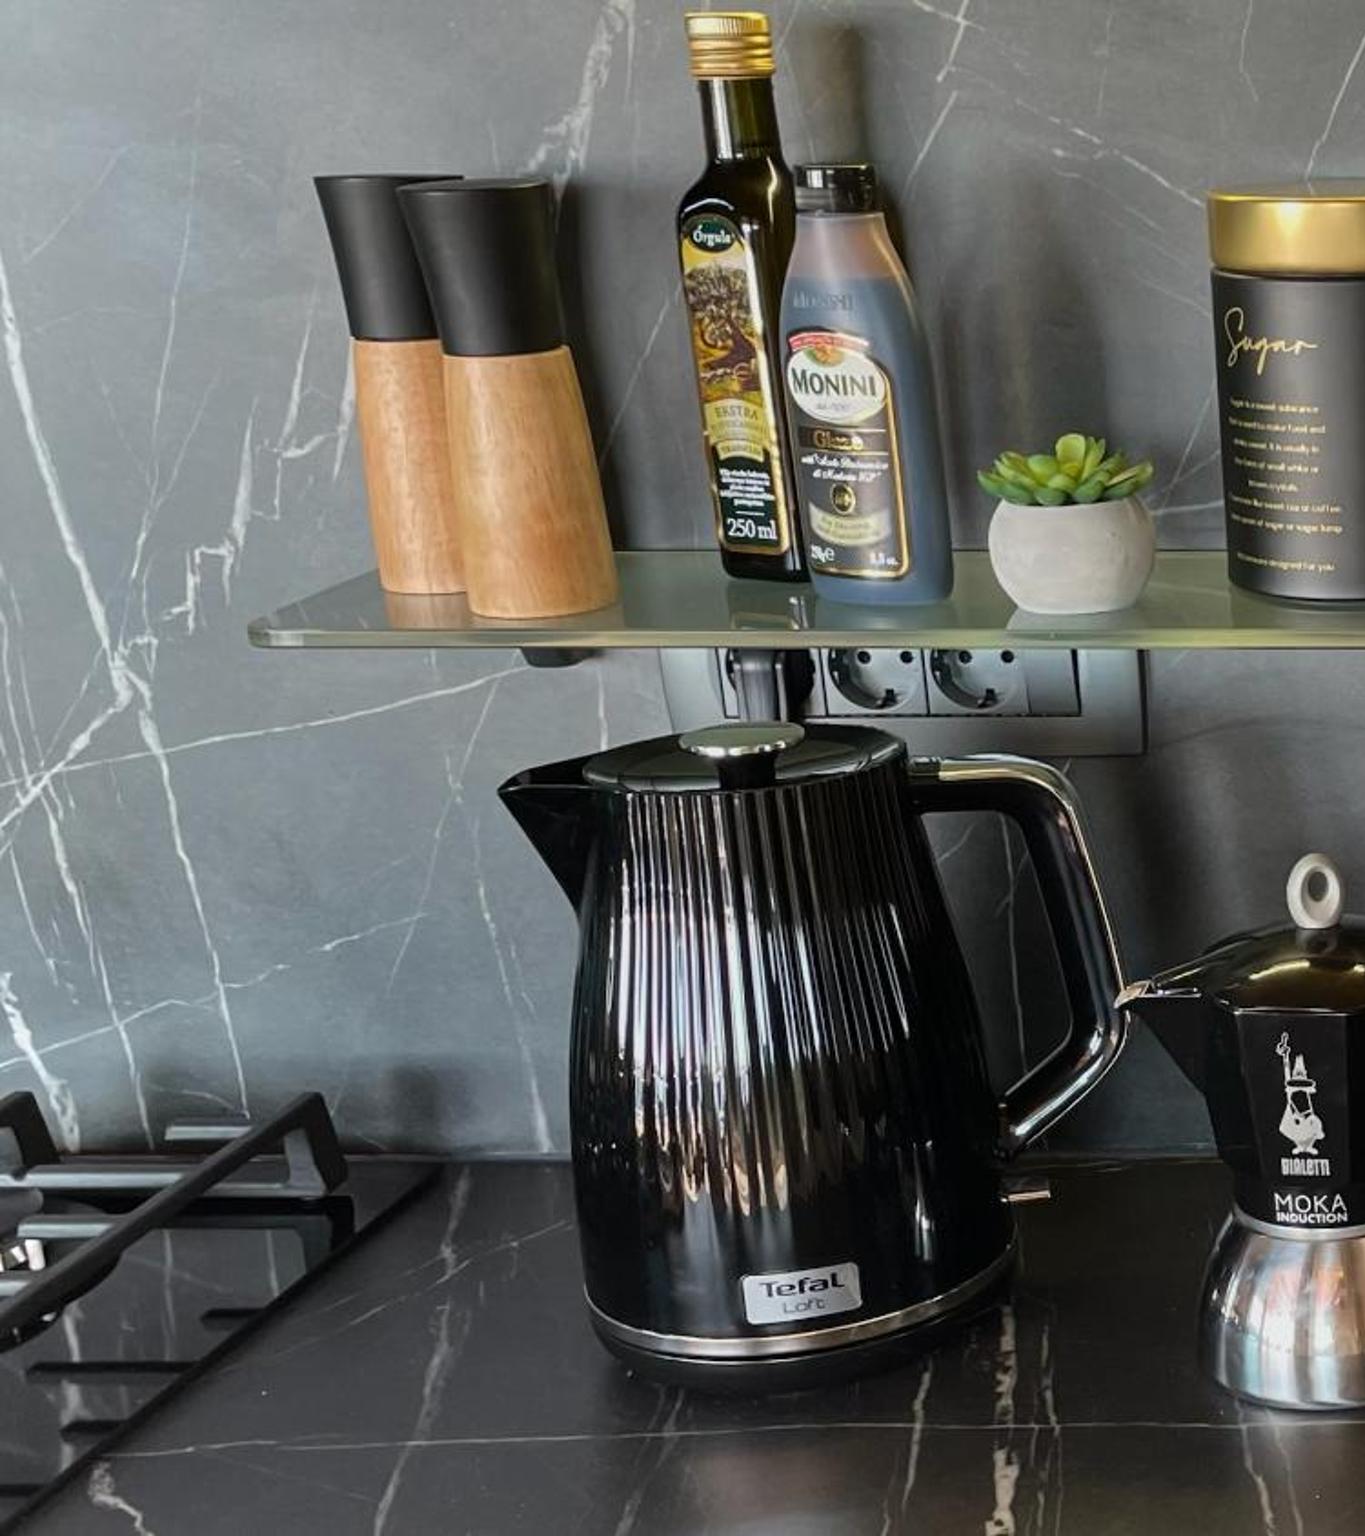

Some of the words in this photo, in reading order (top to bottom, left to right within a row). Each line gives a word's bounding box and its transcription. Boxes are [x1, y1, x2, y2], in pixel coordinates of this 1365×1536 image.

[1224, 307, 1319, 376] Sugar
[791, 366, 878, 397] MONINI
[715, 406, 758, 421] EKSTRA
[727, 517, 756, 538] 250
[757, 519, 778, 540] ml
[1281, 1157, 1331, 1176] BIALETTI
[1274, 1192, 1347, 1213] MOKA
[1276, 1211, 1348, 1224] INDUCTION
[782, 1298, 827, 1314] Loft
